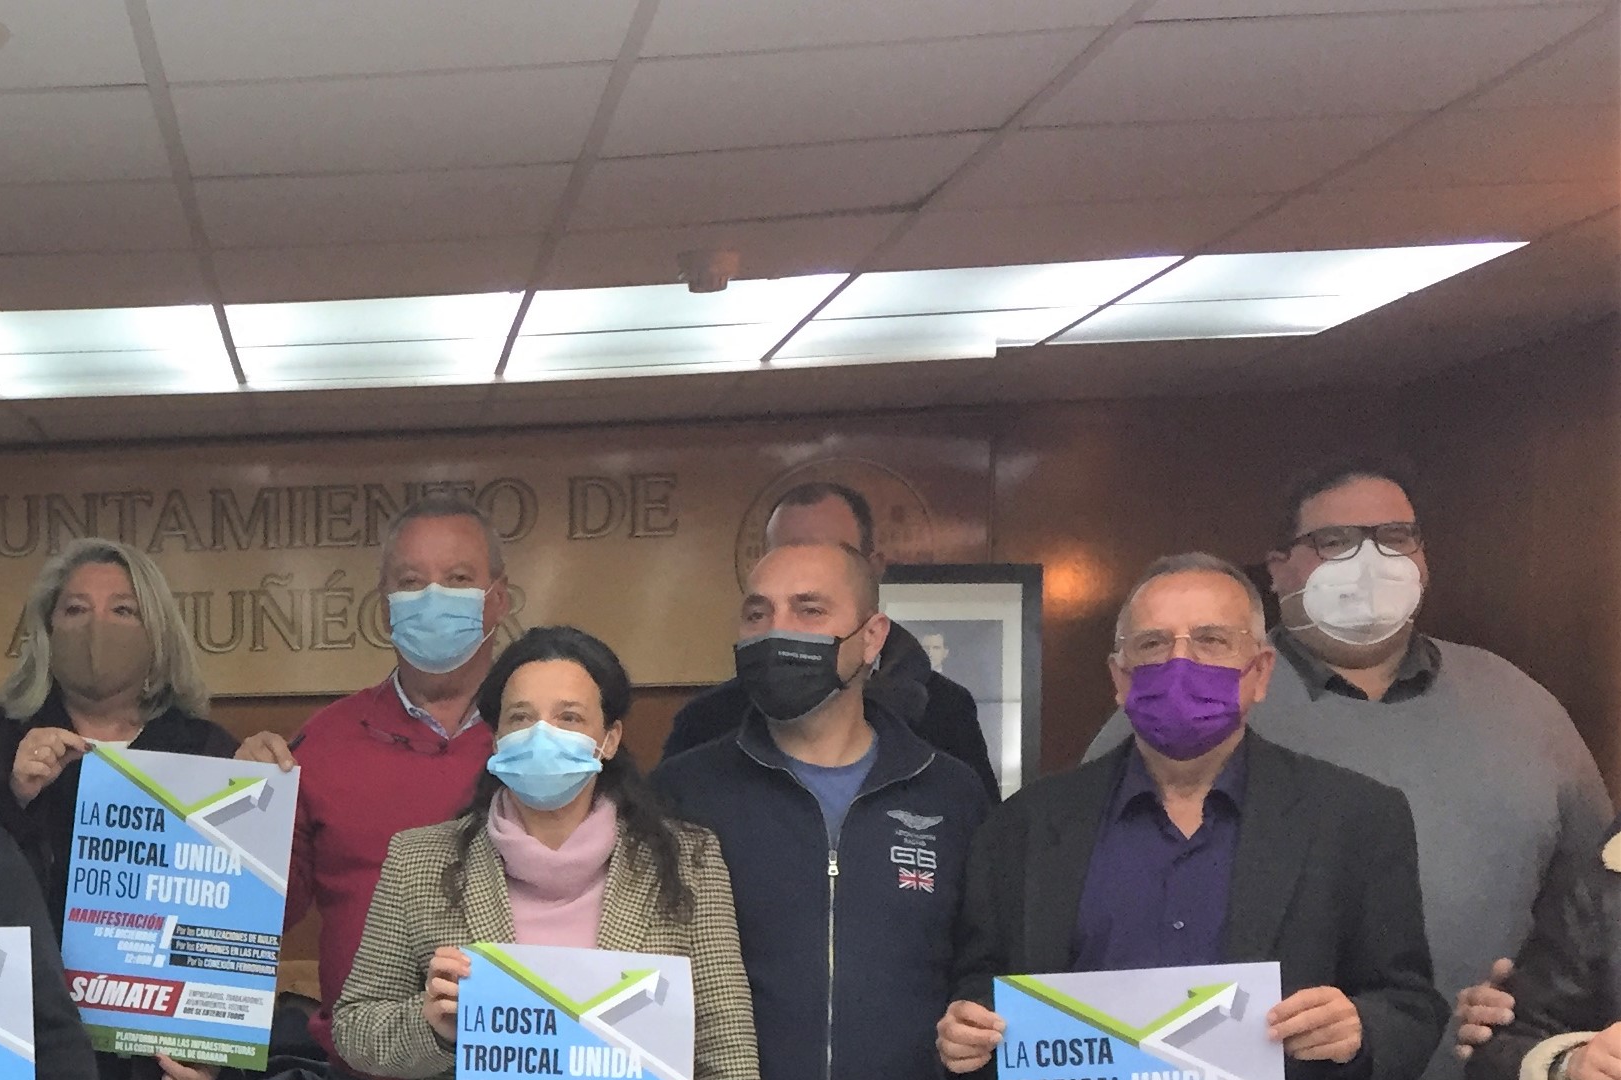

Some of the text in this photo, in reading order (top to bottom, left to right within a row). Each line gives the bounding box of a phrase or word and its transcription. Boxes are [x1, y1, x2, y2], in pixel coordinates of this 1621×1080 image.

[567, 471, 679, 541] DE
[81, 802, 166, 832] LA COSTA
[77, 835, 243, 876] TROPICAL UNIDA
[74, 867, 229, 909] POR SU FUTURO
[68, 974, 172, 1012] SÚMATE
[465, 1005, 556, 1035] LA COSTA
[462, 1044, 642, 1078] TROPICAL UNIDA
[1005, 1038, 1112, 1067] LA COSTA
